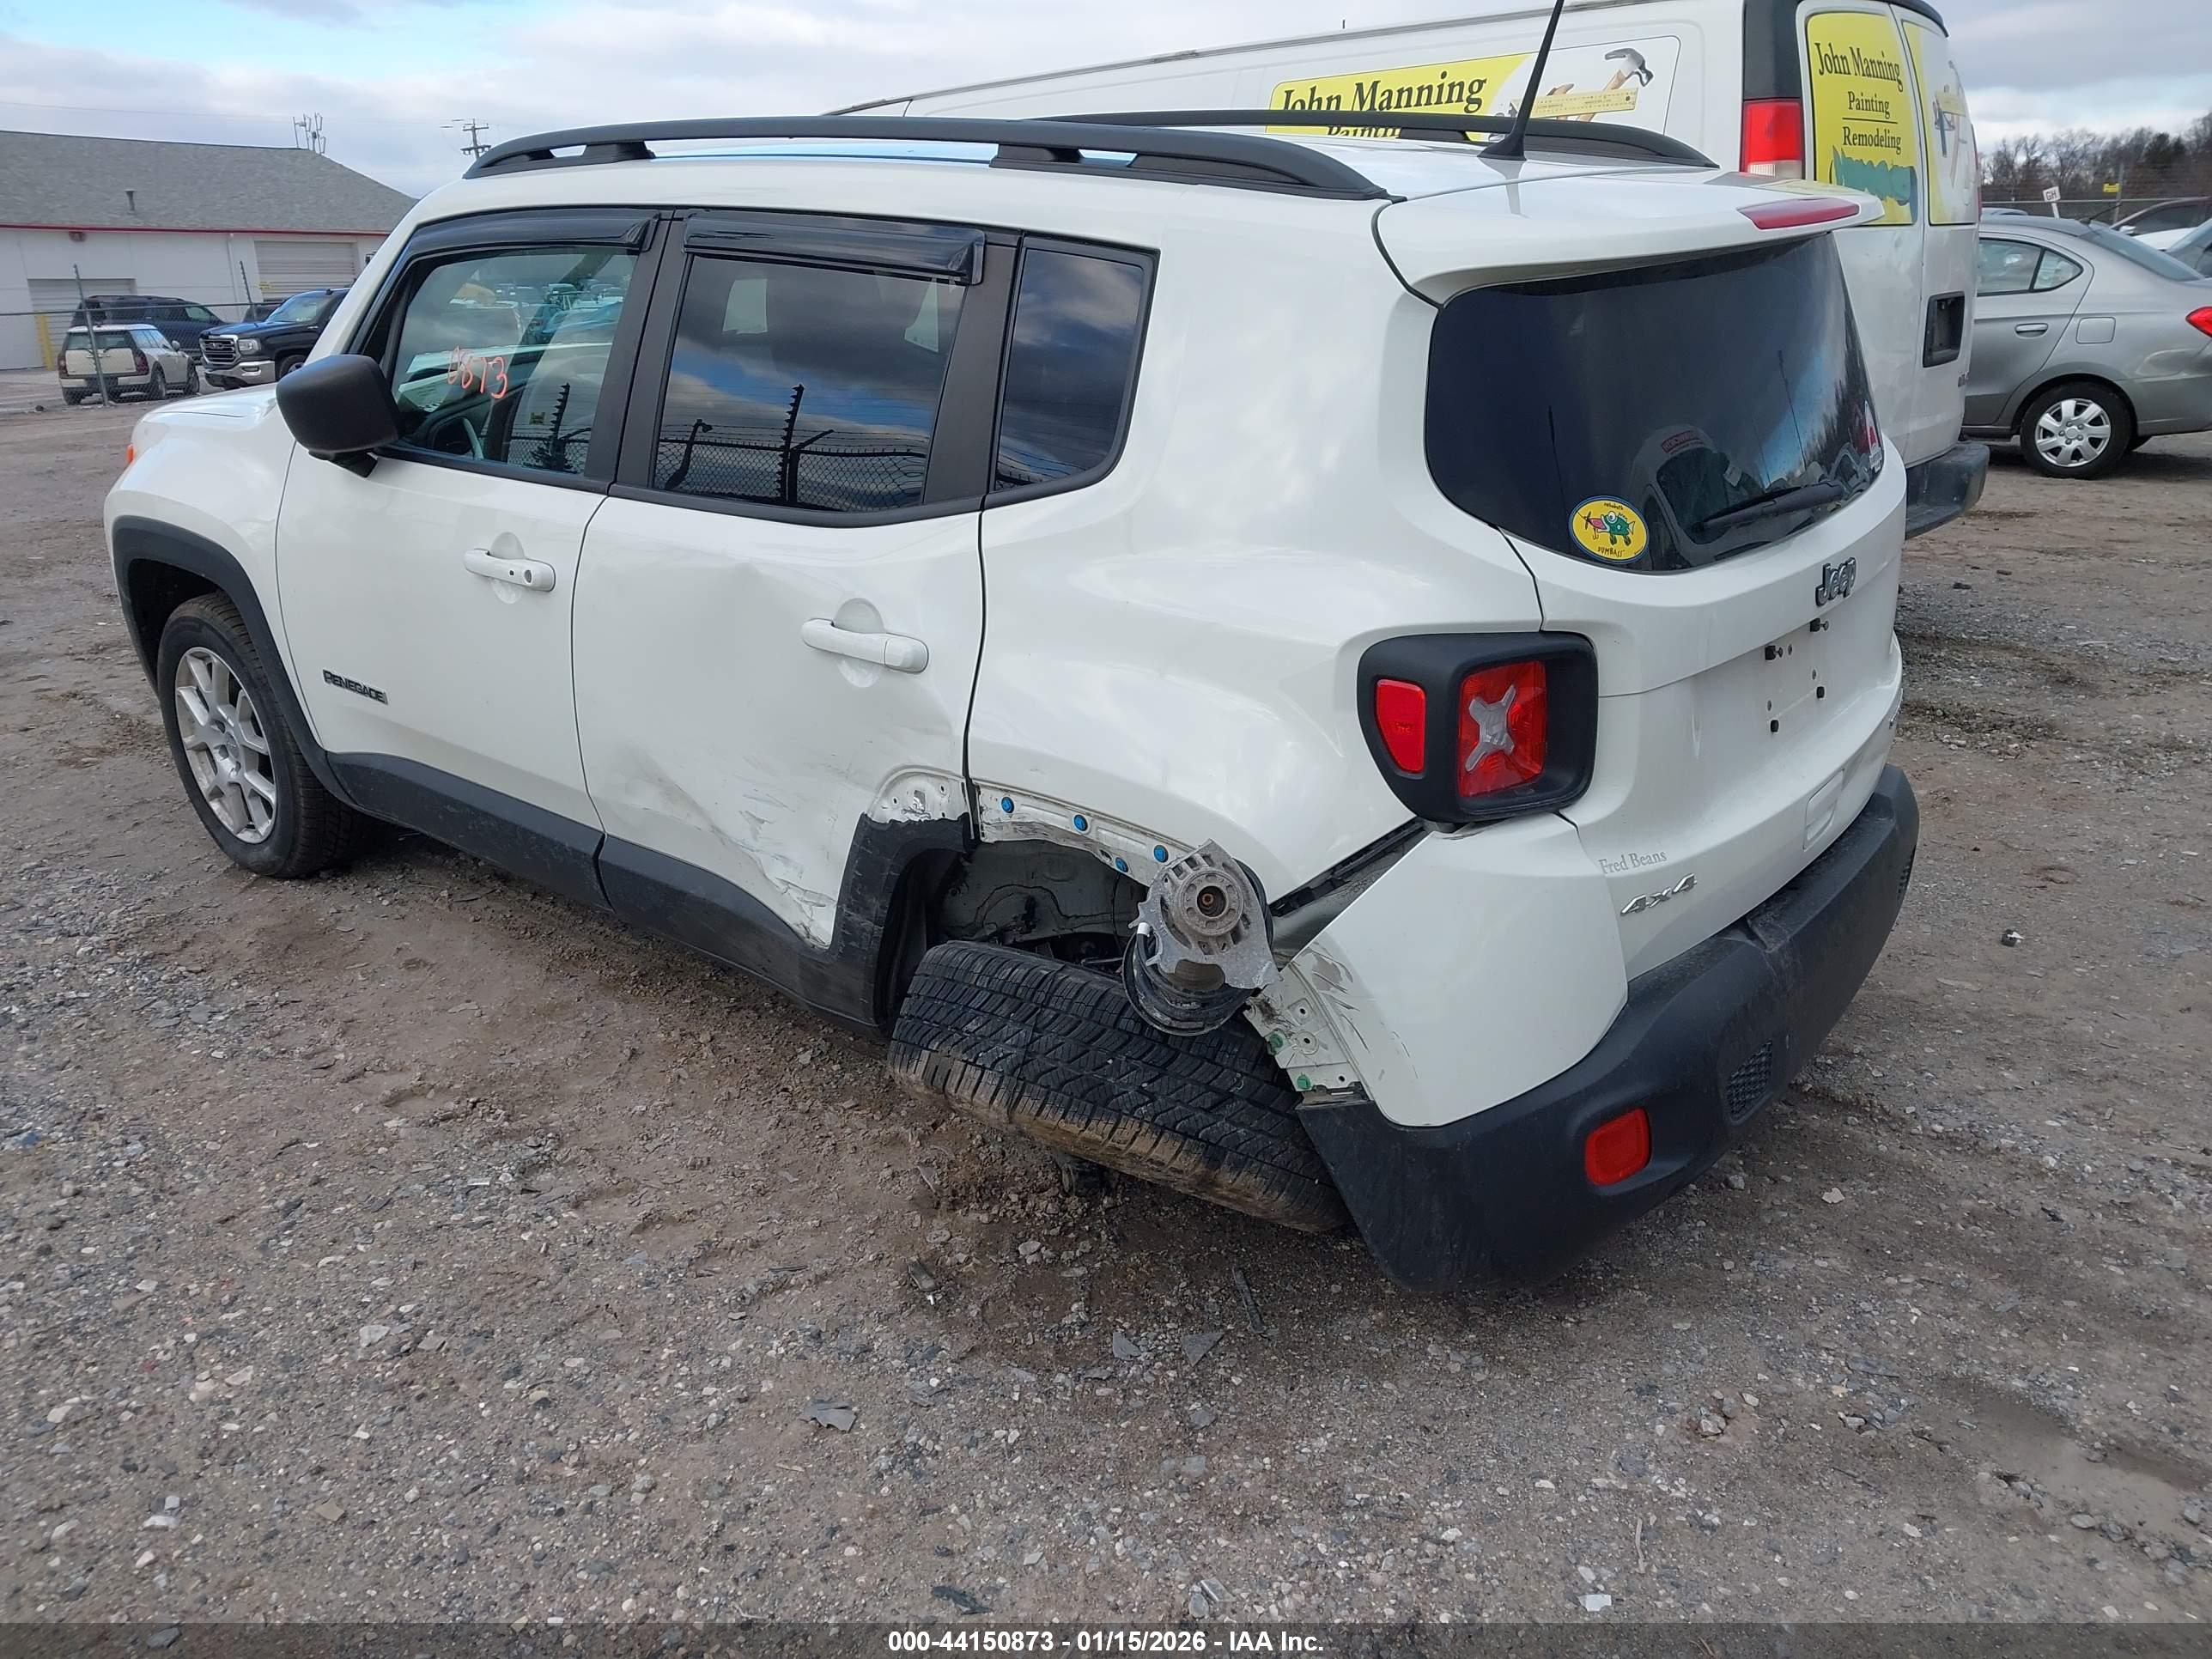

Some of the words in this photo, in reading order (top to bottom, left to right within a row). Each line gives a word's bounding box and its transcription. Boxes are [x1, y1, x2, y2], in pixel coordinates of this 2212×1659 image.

[1814, 43, 1850, 76] John
[1850, 47, 1903, 92] Manning
[1352, 70, 1487, 114] Manning
[1849, 91, 1891, 118] Painting
[1843, 126, 1901, 155] Remodeling
[1815, 557, 1856, 607] Jeep
[323, 669, 388, 705] RENEGADE
[1599, 854, 1628, 873] Fred
[1628, 851, 1668, 868] Beans
[1620, 872, 1698, 916] 4x4
